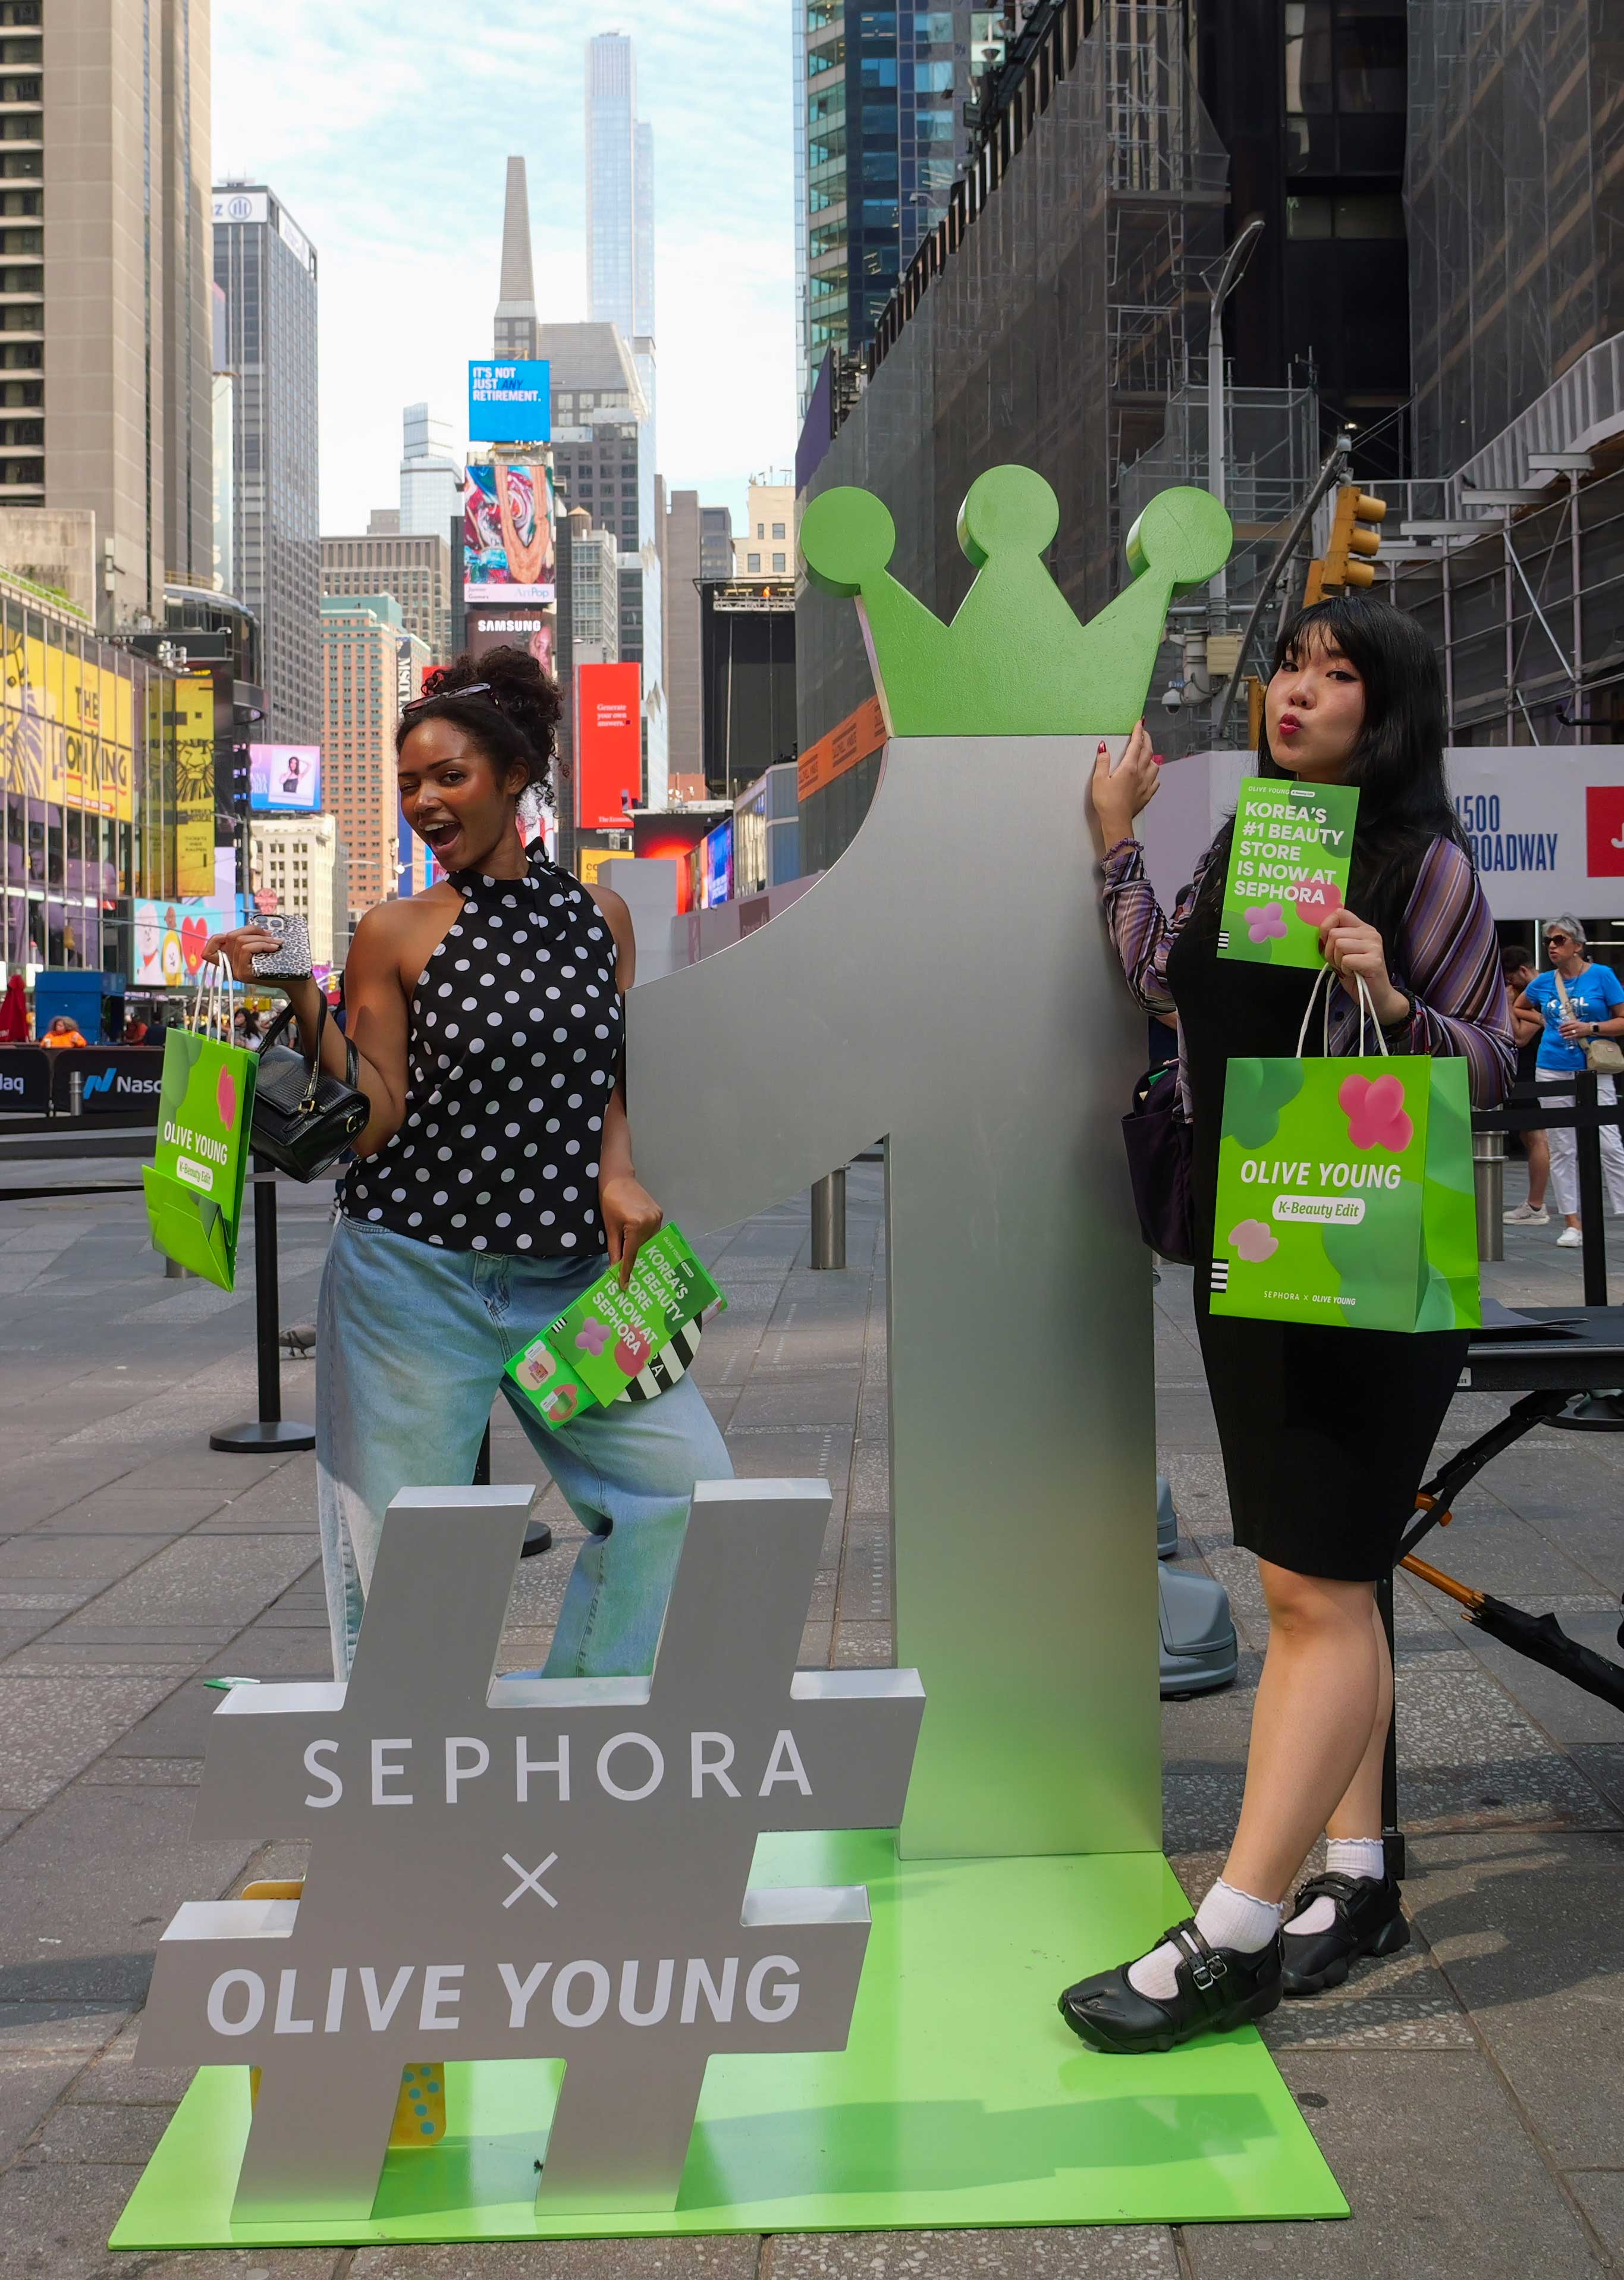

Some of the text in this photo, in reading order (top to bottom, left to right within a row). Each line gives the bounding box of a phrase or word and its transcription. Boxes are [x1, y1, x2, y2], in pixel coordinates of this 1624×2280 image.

[473, 366, 516, 378] IT'S NOT
[473, 378, 523, 390] JUST ANY
[473, 390, 542, 401] RETIREMENT.
[478, 620, 541, 632] SAMSUNG
[75, 686, 100, 720] THE
[91, 730, 127, 793] KING
[1245, 801, 1327, 824] KOREA'S
[1456, 794, 1500, 833] 1500
[1242, 821, 1345, 846] #1 BEAUTY
[1239, 840, 1302, 862] STORE
[1470, 833, 1558, 872] ROADWAY
[1237, 860, 1337, 885] IS NOW AT
[1234, 880, 1325, 905] SEPHORA
[164, 1120, 228, 1166] OLIVE YOUNG
[201, 1170, 211, 1185] Edit
[1240, 1160, 1402, 1190] OLIVE YOUNG
[1279, 1201, 1360, 1219] K-Beauty Edit
[645, 1245, 689, 1300] KOREA'S
[633, 1258, 649, 1275] #1
[643, 1271, 684, 1322] BEAUTY
[1264, 1290, 1299, 1301] SEPHORA
[1312, 1294, 1332, 1304] OLIVE
[1333, 1296, 1356, 1306] YOUNG
[592, 1291, 642, 1356] SEPHORA
[604, 1279, 620, 1296] IS
[615, 1293, 646, 1329] NOW
[639, 1326, 659, 1345] AT
[302, 1729, 815, 1810] SEPHORA
[205, 1954, 802, 2037] OLIVE YOUNG
